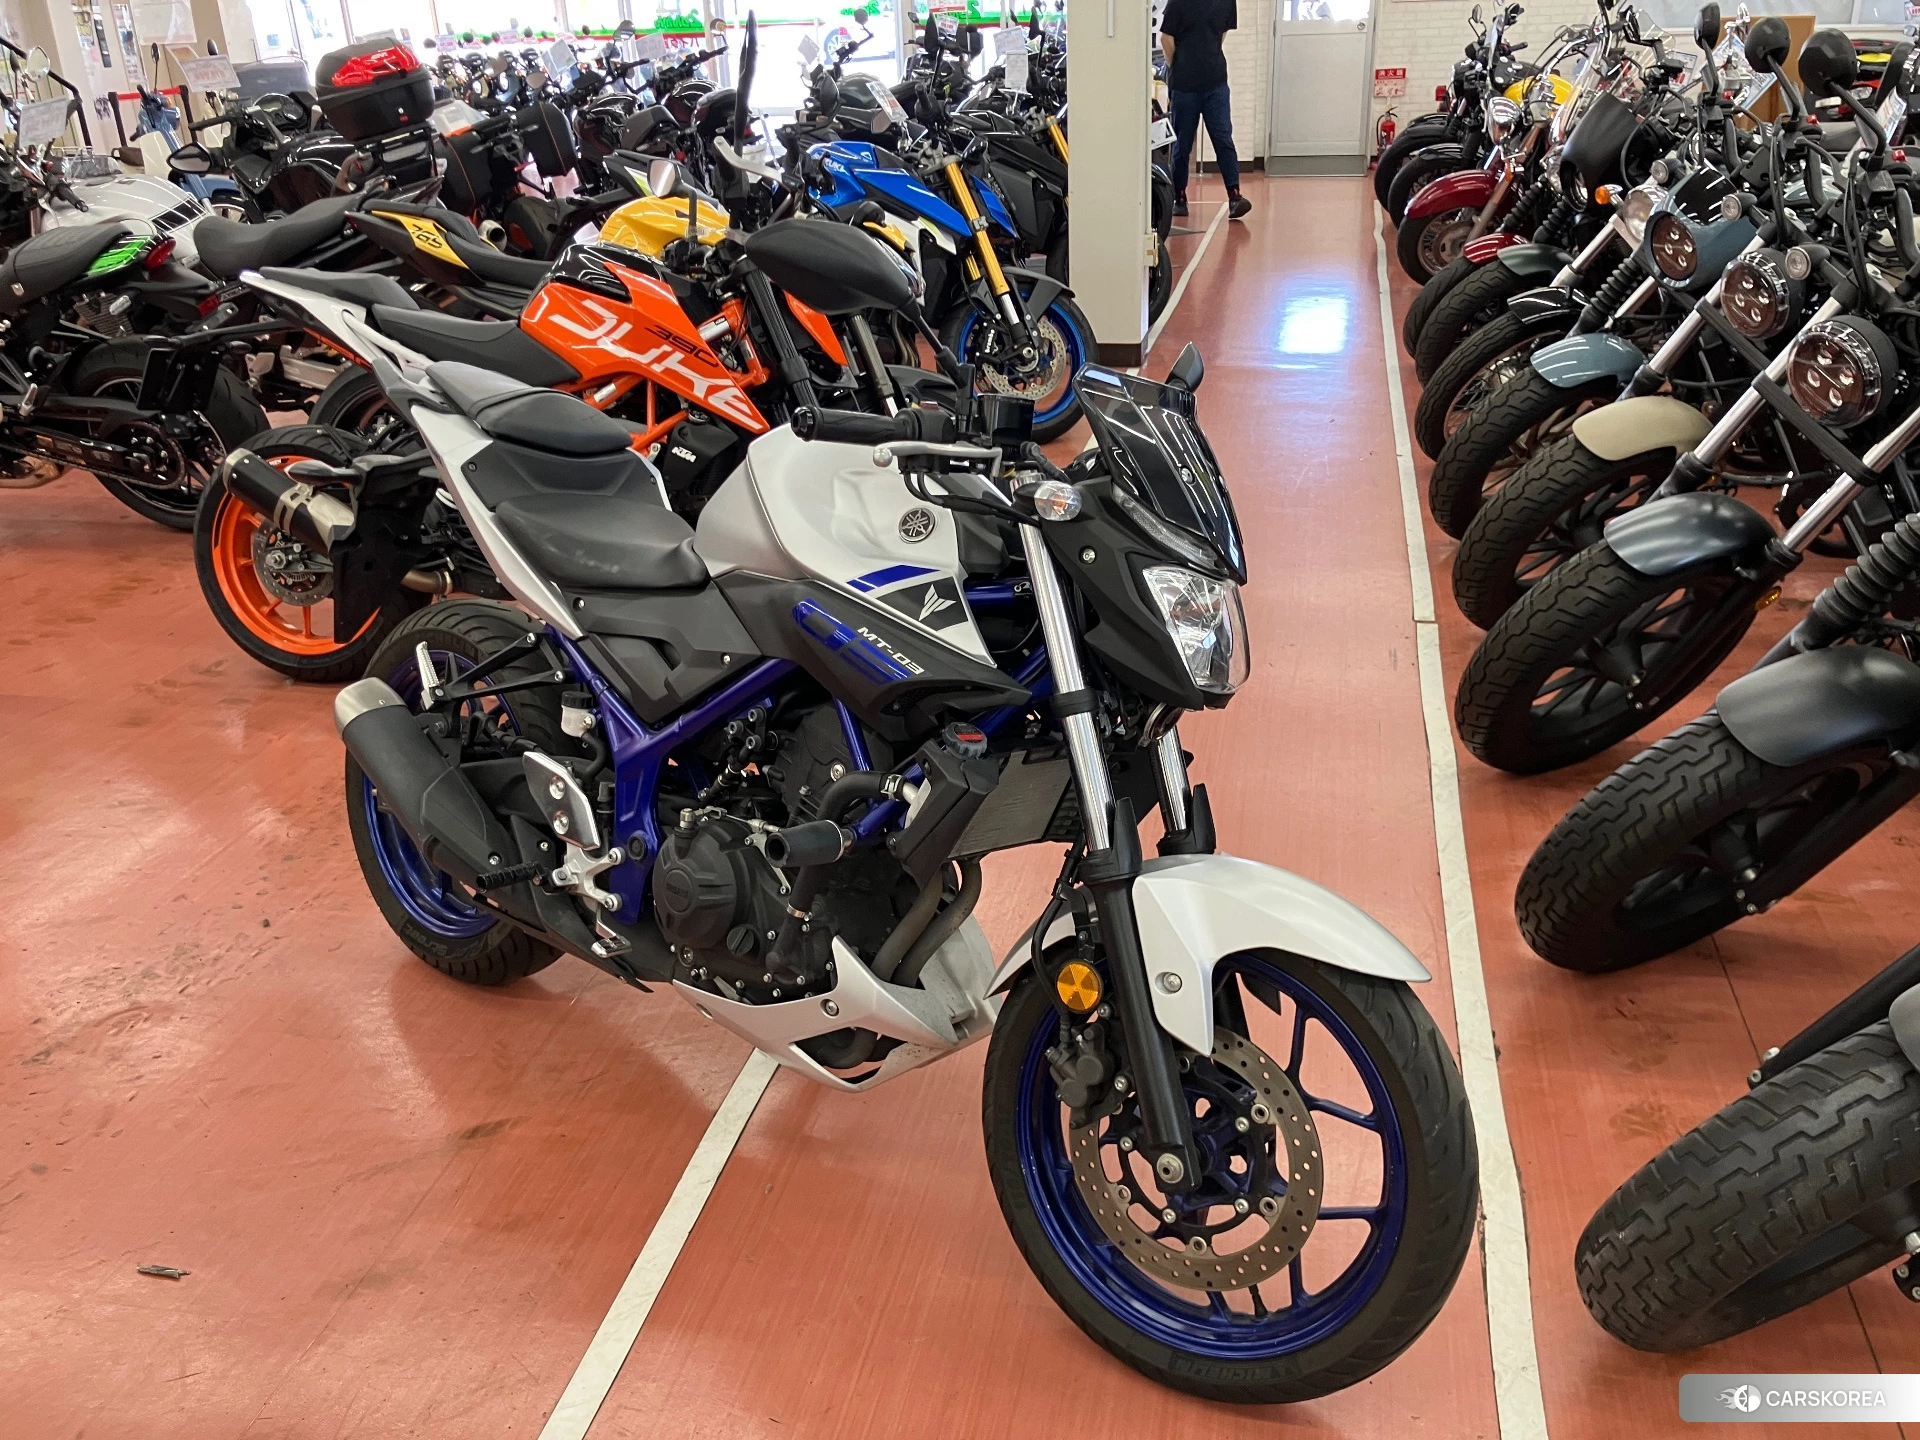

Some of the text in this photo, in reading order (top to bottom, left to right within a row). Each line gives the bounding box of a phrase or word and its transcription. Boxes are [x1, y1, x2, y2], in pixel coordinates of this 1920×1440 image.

[548, 299, 764, 430] DUKE
[644, 324, 719, 368] 390
[671, 446, 697, 463] KTM
[857, 626, 925, 675] MT-03
